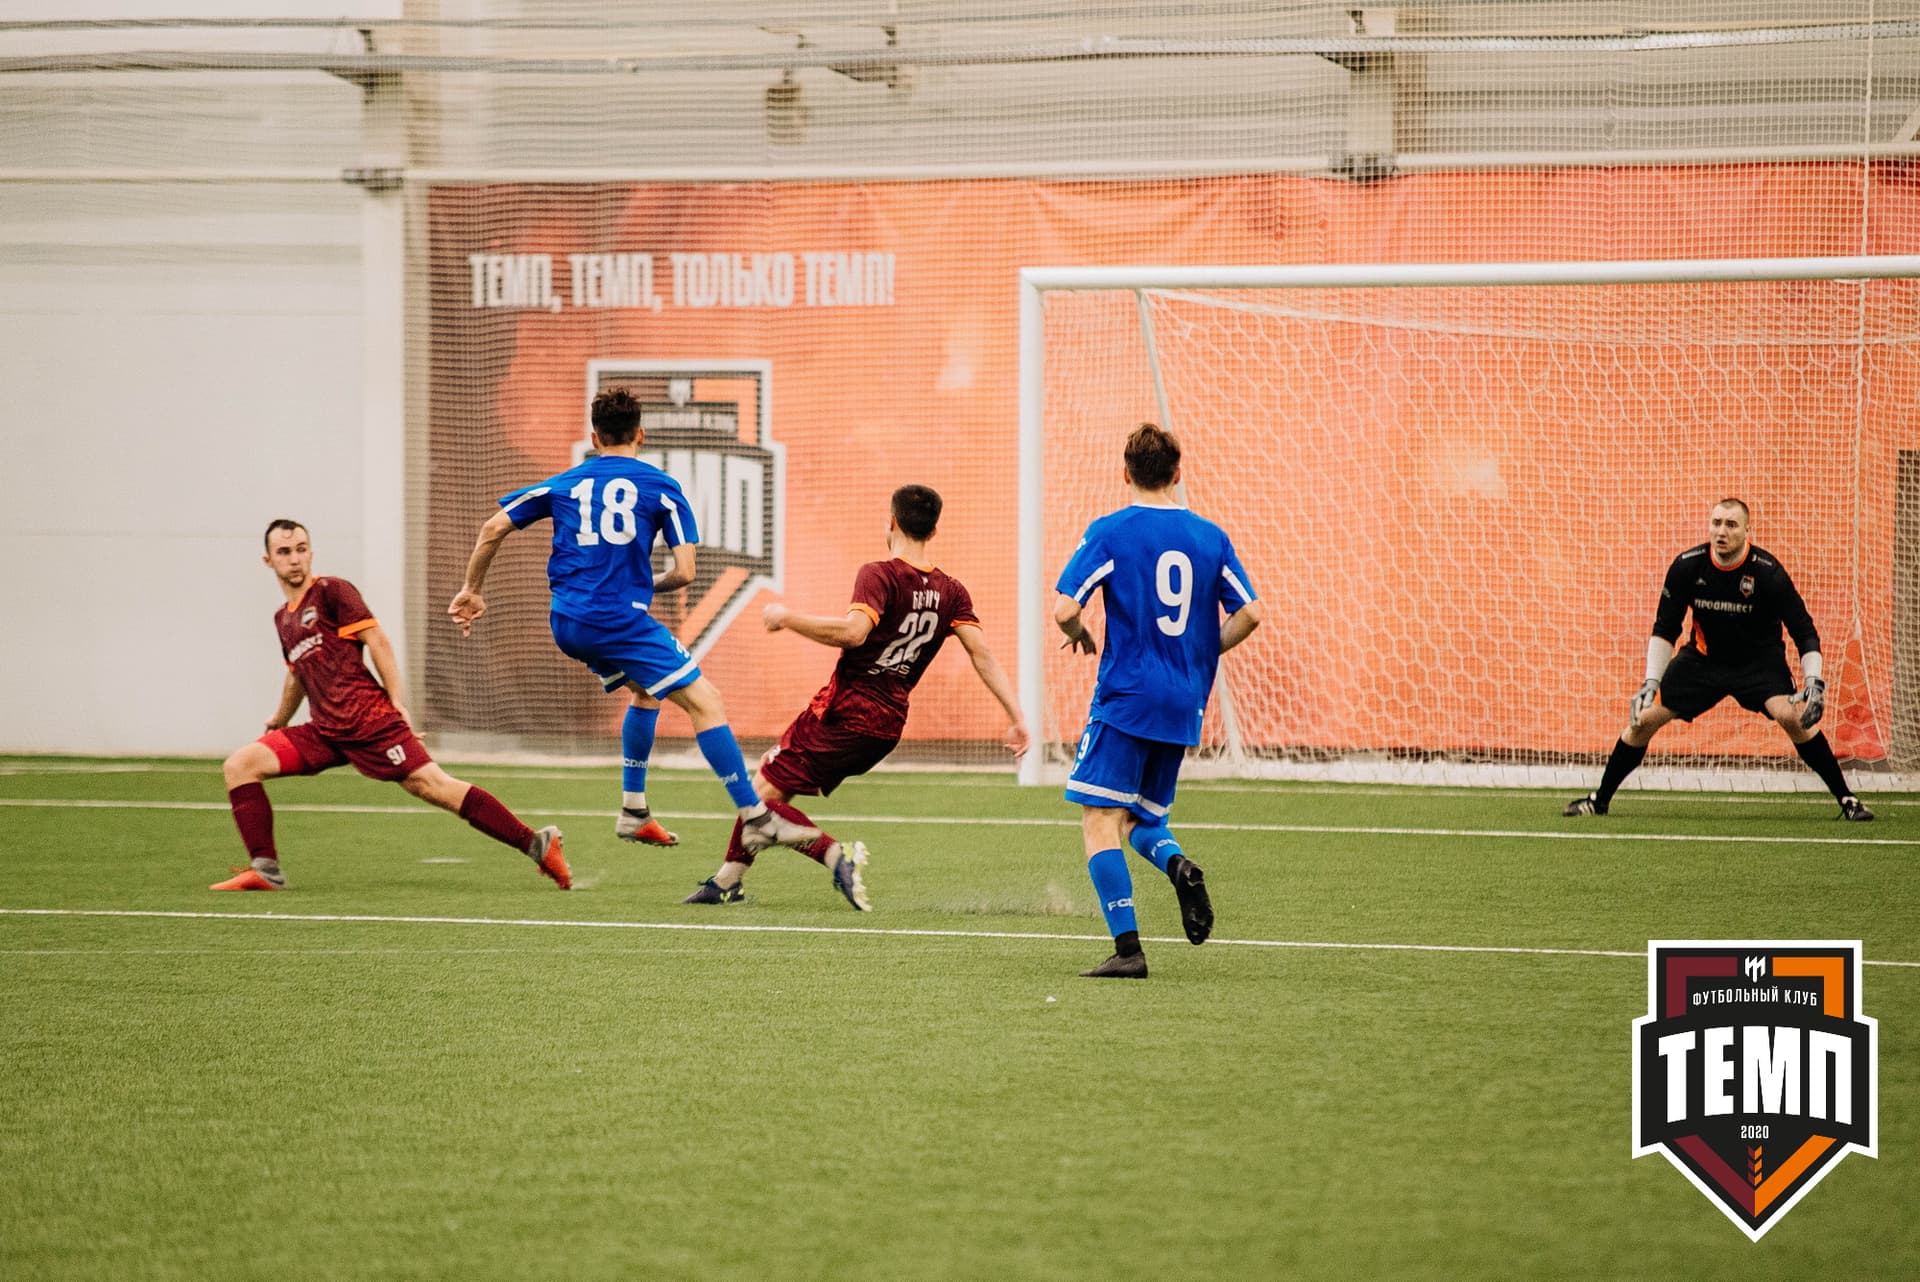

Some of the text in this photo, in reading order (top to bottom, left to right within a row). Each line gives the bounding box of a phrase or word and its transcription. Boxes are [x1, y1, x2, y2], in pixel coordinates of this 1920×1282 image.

[469, 251, 896, 313] ТЕМП, ТЕМП, ТОЛЬКО ТЕМП!
[570, 477, 638, 546] 18
[1156, 550, 1194, 637] 9
[875, 611, 939, 668] 22
[1077, 732, 1091, 760] 9
